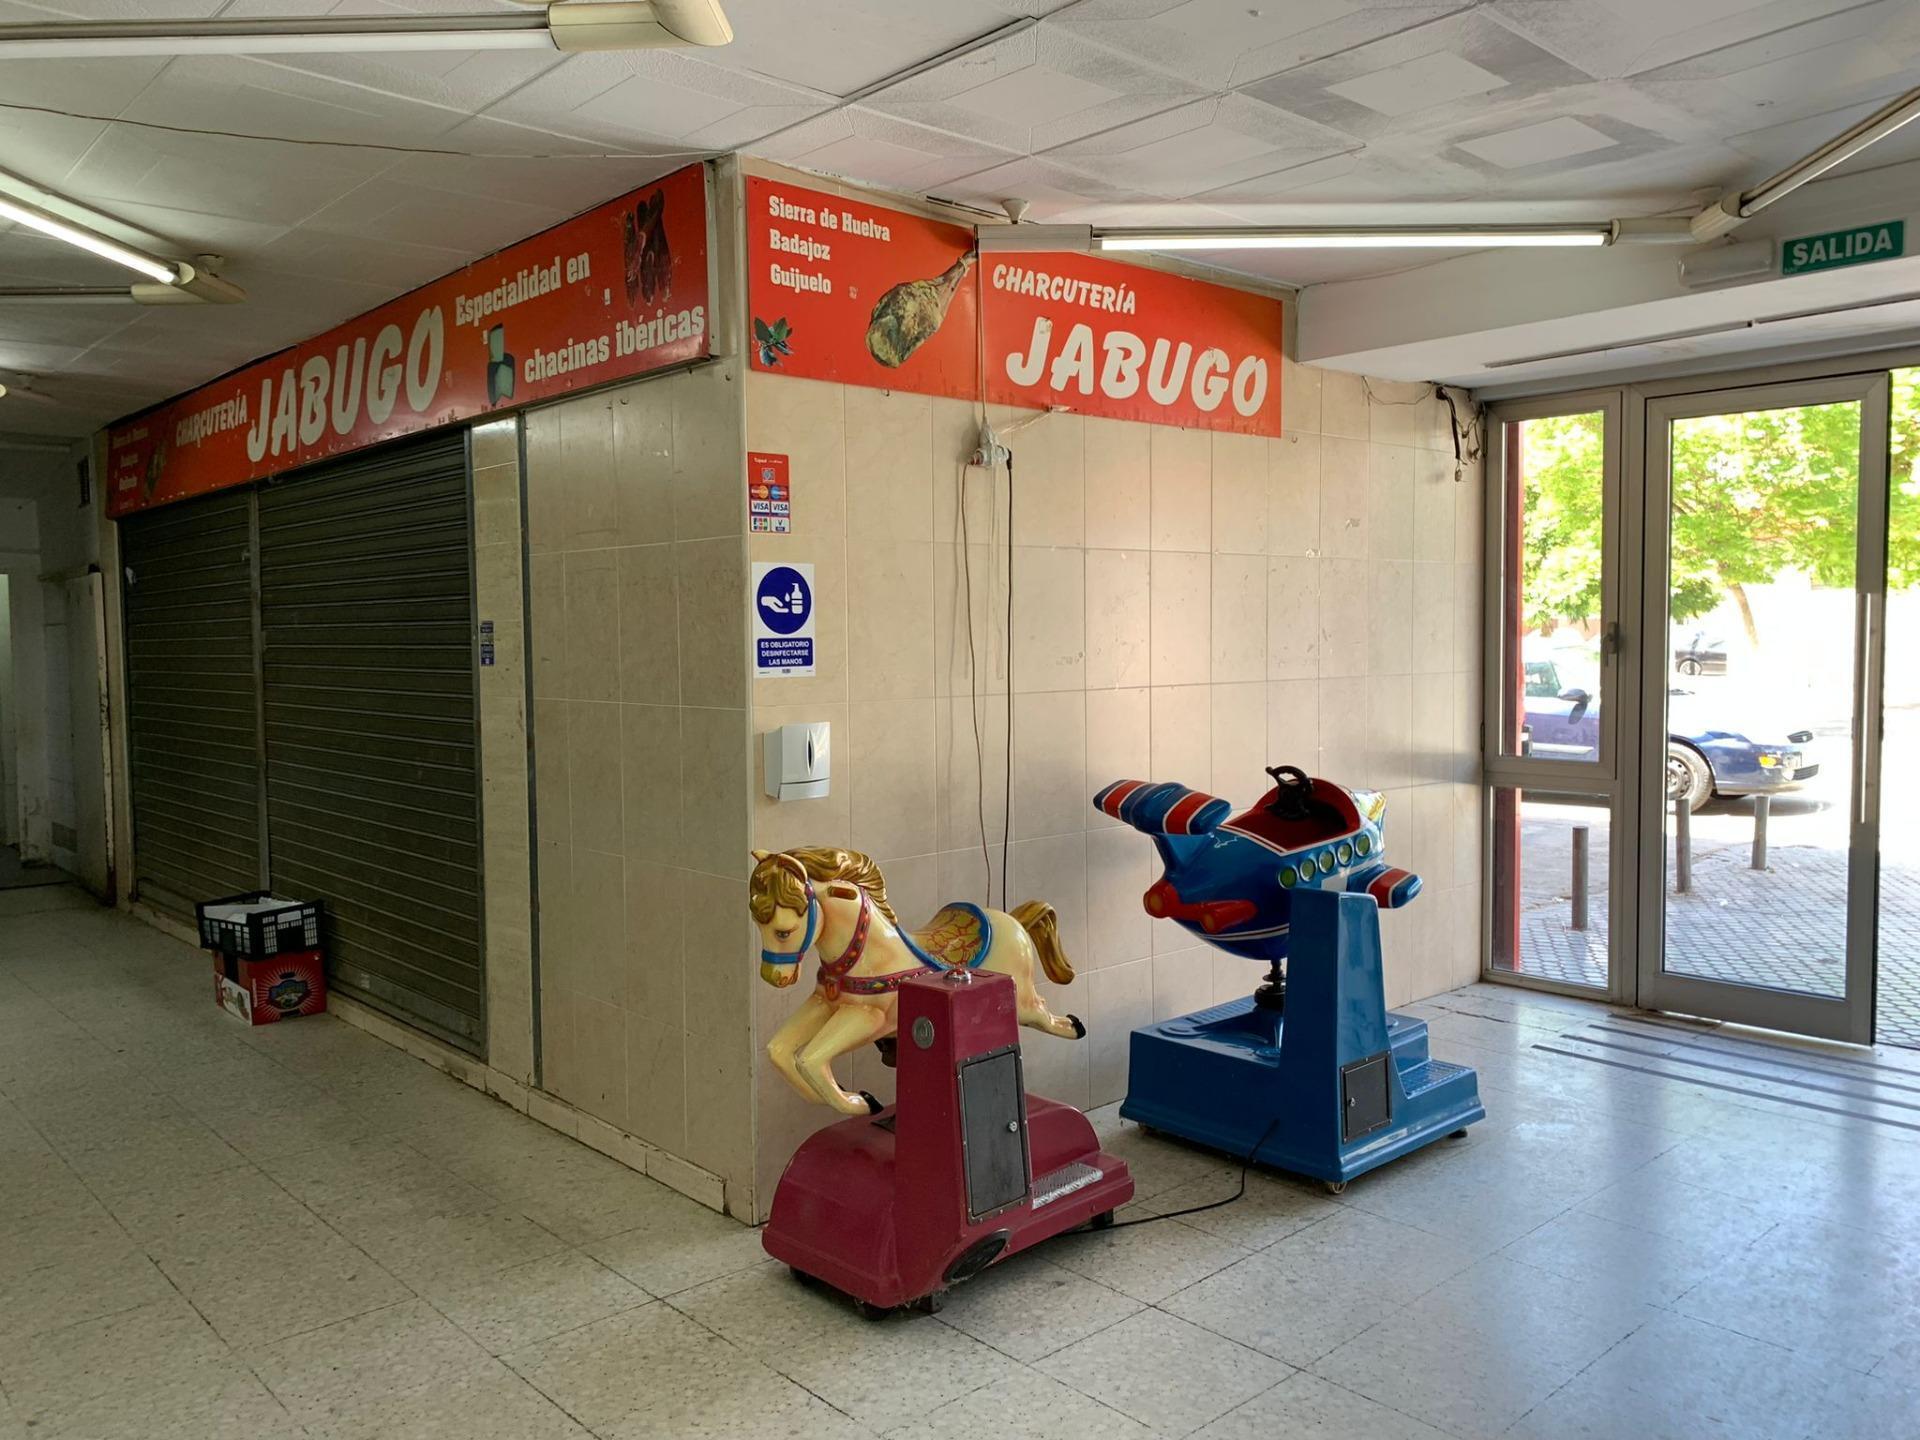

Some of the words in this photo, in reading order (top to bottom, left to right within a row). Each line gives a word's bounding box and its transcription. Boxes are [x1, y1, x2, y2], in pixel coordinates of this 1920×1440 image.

[769, 195, 816, 225] Sierra
[820, 208, 838, 229] de
[842, 212, 891, 242] Huelva
[769, 228, 831, 262] Badajoz
[1792, 228, 1893, 266] SALIDA
[455, 255, 562, 328] Especialidad
[566, 252, 591, 285] en
[770, 263, 832, 295] Guijuelo
[992, 263, 1136, 315] CHARCUTERÍA
[524, 338, 610, 384] chacinas
[615, 305, 705, 358] ibéricas
[1005, 316, 1268, 417] JABUGO
[246, 304, 445, 463] JABUGO
[175, 388, 248, 449] CHARCUTERÍA
